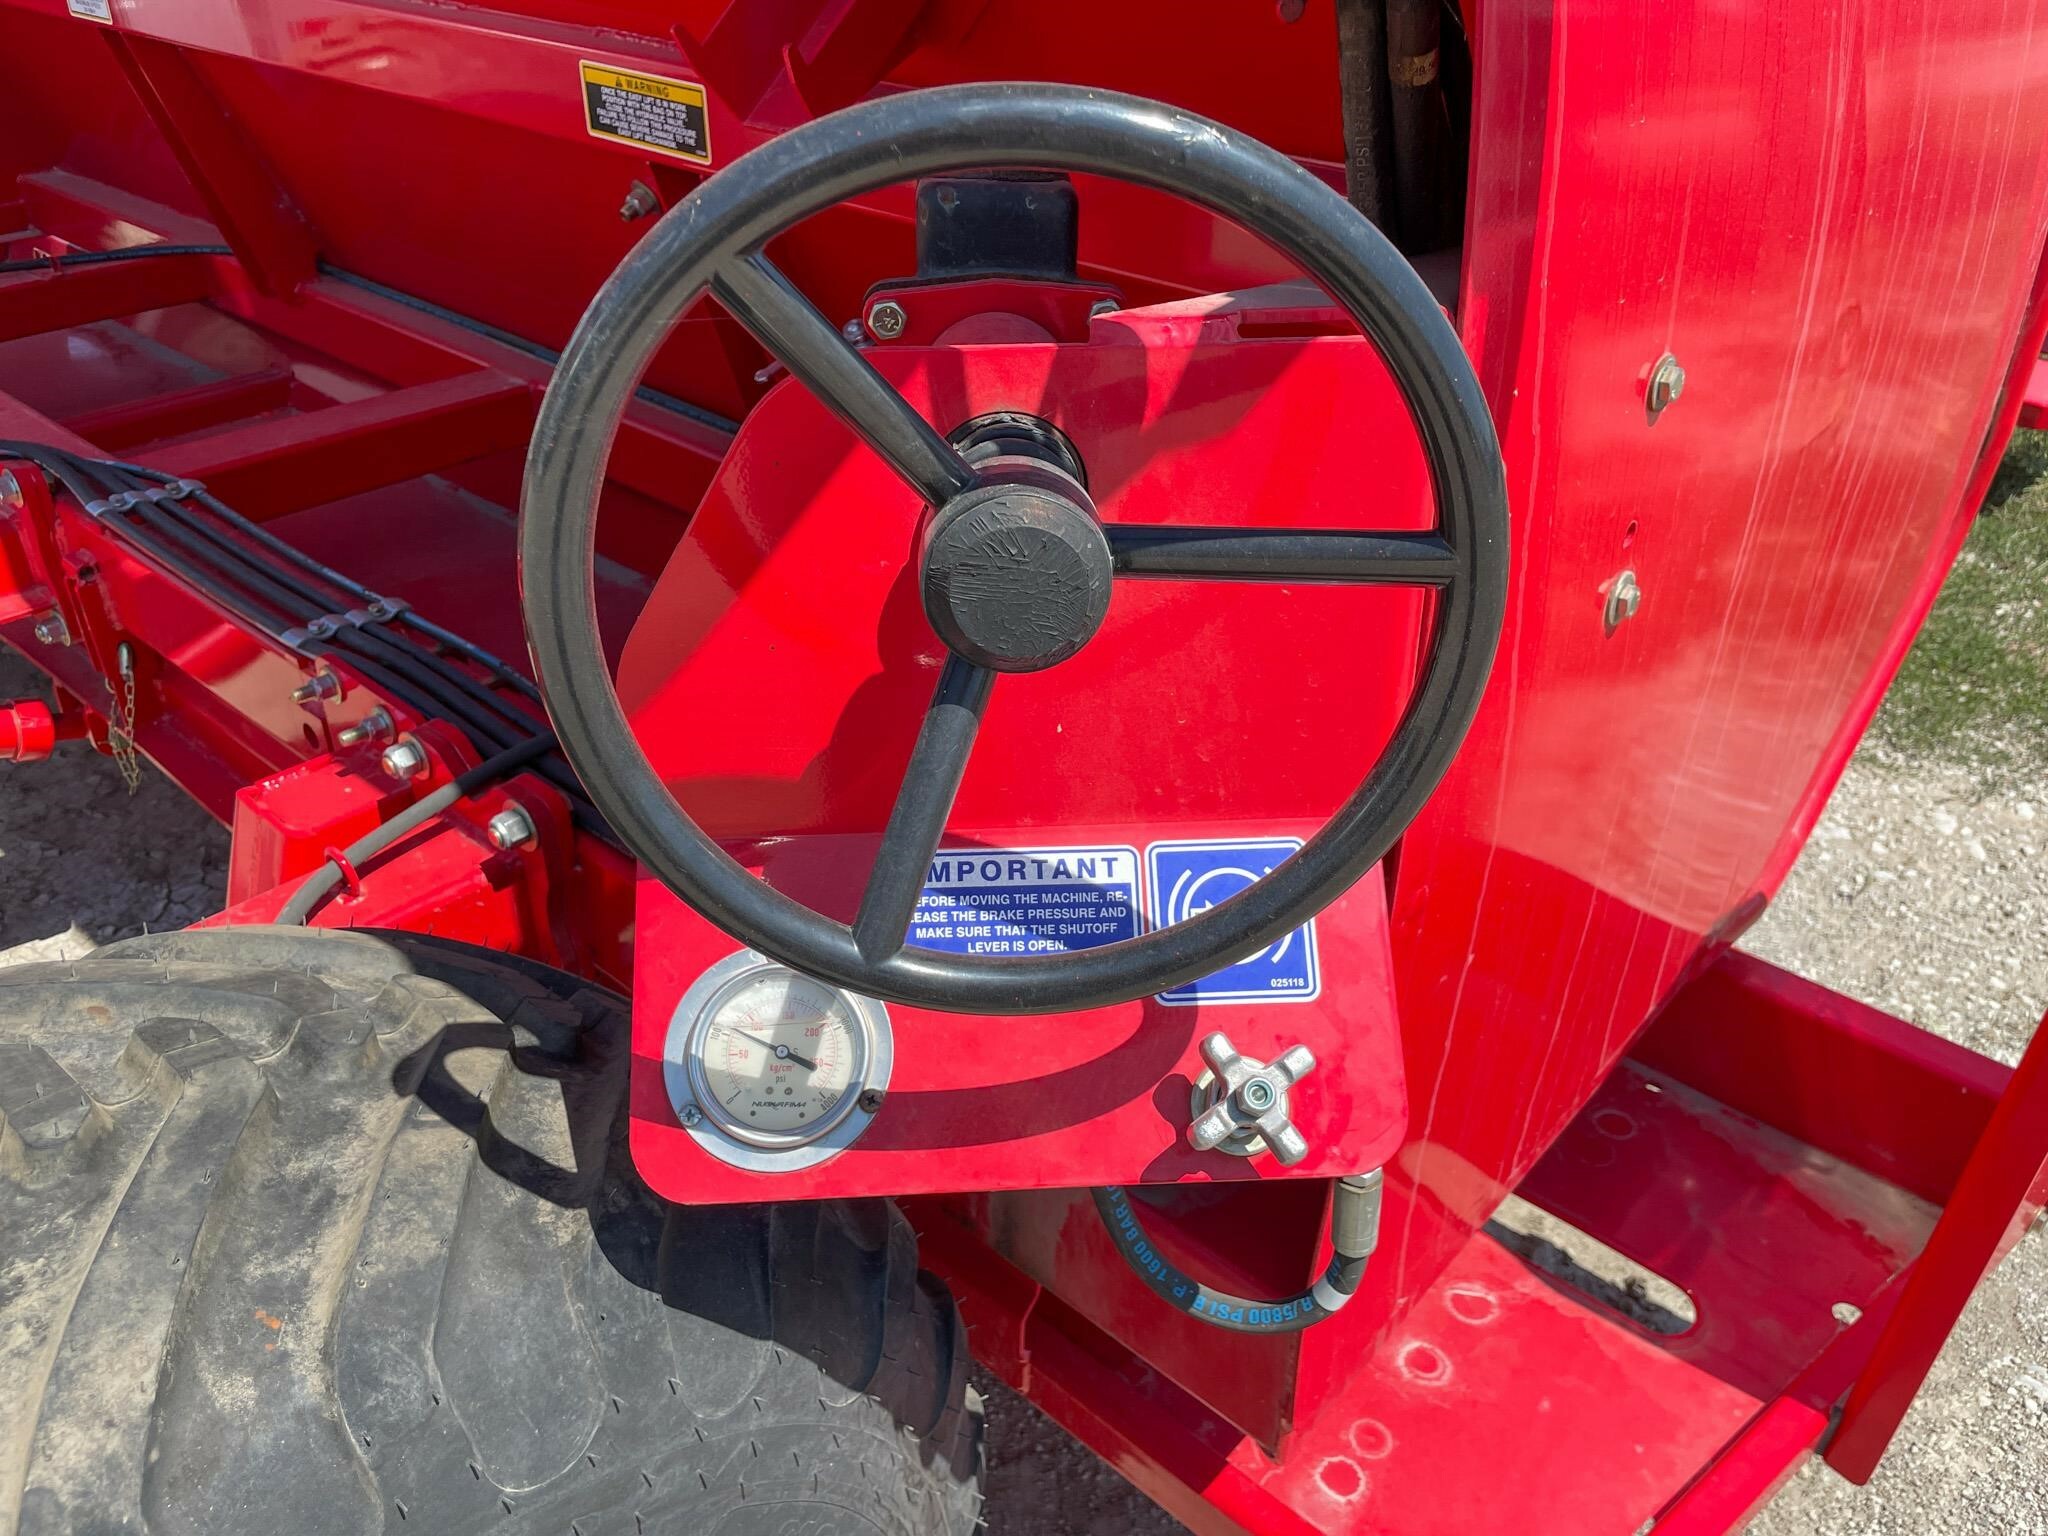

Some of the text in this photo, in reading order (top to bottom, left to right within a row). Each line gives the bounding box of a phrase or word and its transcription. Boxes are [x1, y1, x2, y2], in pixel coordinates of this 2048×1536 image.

[626, 78, 669, 97] WARNING
[927, 857, 1118, 883] MPORTANT
[959, 894, 1010, 906] MOVING
[1013, 893, 1038, 905] THE
[1042, 892, 1103, 904] MACHINE,
[1107, 891, 1128, 902] RE-
[951, 910, 976, 922] THE
[980, 909, 1025, 921] BRAKE
[1028, 908, 1096, 920] PRESSURE
[1100, 907, 1127, 918] AND
[916, 922, 1118, 938] MAKE SURE THAT THE SHUTOFF
[967, 940, 1068, 953] LEVER IS OPEN.
[1271, 977, 1305, 988] 025118
[804, 1027, 820, 1037] 200
[738, 1049, 749, 1059] 50
[775, 1075, 786, 1084] psi
[726, 1097, 735, 1105] 0
[1114, 1207, 1140, 1241] BAR
[1133, 1240, 1167, 1282] 1600
[1208, 1302, 1243, 1323] PSI
